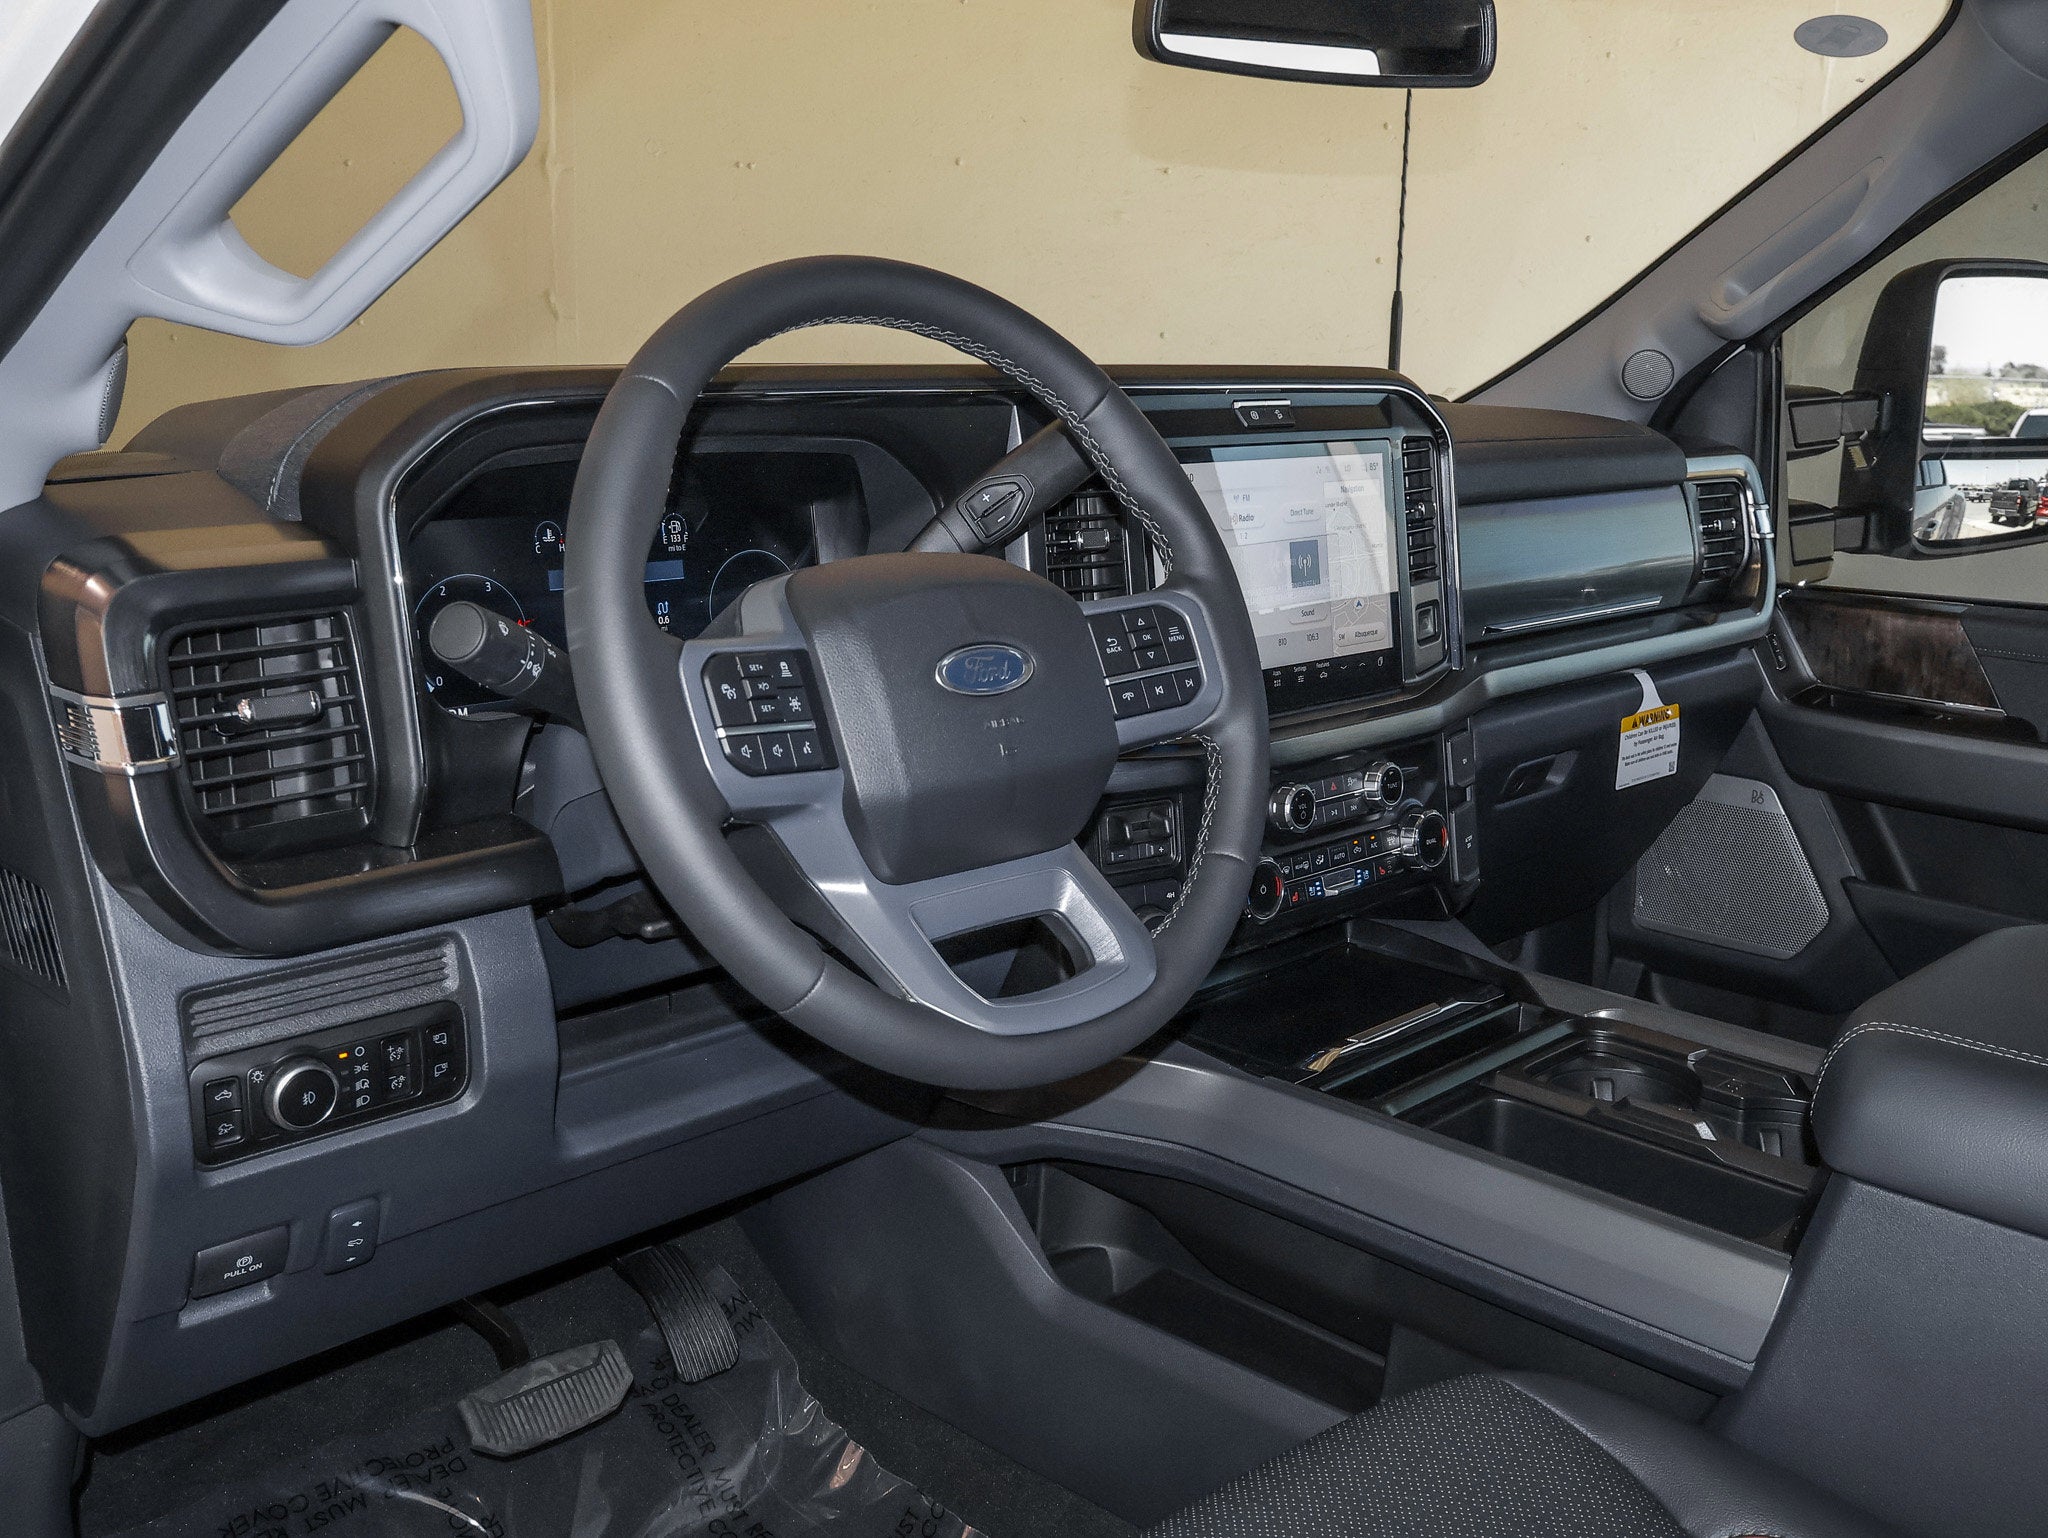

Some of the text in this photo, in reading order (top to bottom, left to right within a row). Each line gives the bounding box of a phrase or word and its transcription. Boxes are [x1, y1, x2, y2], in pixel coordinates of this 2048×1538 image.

[1341, 485, 1364, 494] Navigation
[1238, 513, 1255, 522] Radio
[662, 536, 668, 545] E
[670, 534, 681, 543] 133
[684, 534, 689, 543] F
[559, 543, 565, 552] H
[439, 585, 446, 596] 2
[485, 581, 491, 592] 3
[1301, 608, 1315, 618] Sound
[658, 615, 670, 625] 0.6
[1142, 633, 1152, 641] OK
[1168, 634, 1185, 642] MENU
[1354, 629, 1378, 639] Albuquerque
[1106, 646, 1122, 654] BACK
[964, 656, 1011, 683] Ford
[436, 676, 443, 686] 0
[1639, 709, 1670, 727] WARNING
[1333, 852, 1346, 860] AUTO
[223, 1262, 263, 1280] PULL ON
[662, 1393, 716, 1458] DEALER
[217, 1494, 309, 1538] COVER
[305, 1493, 367, 1533] MUST
